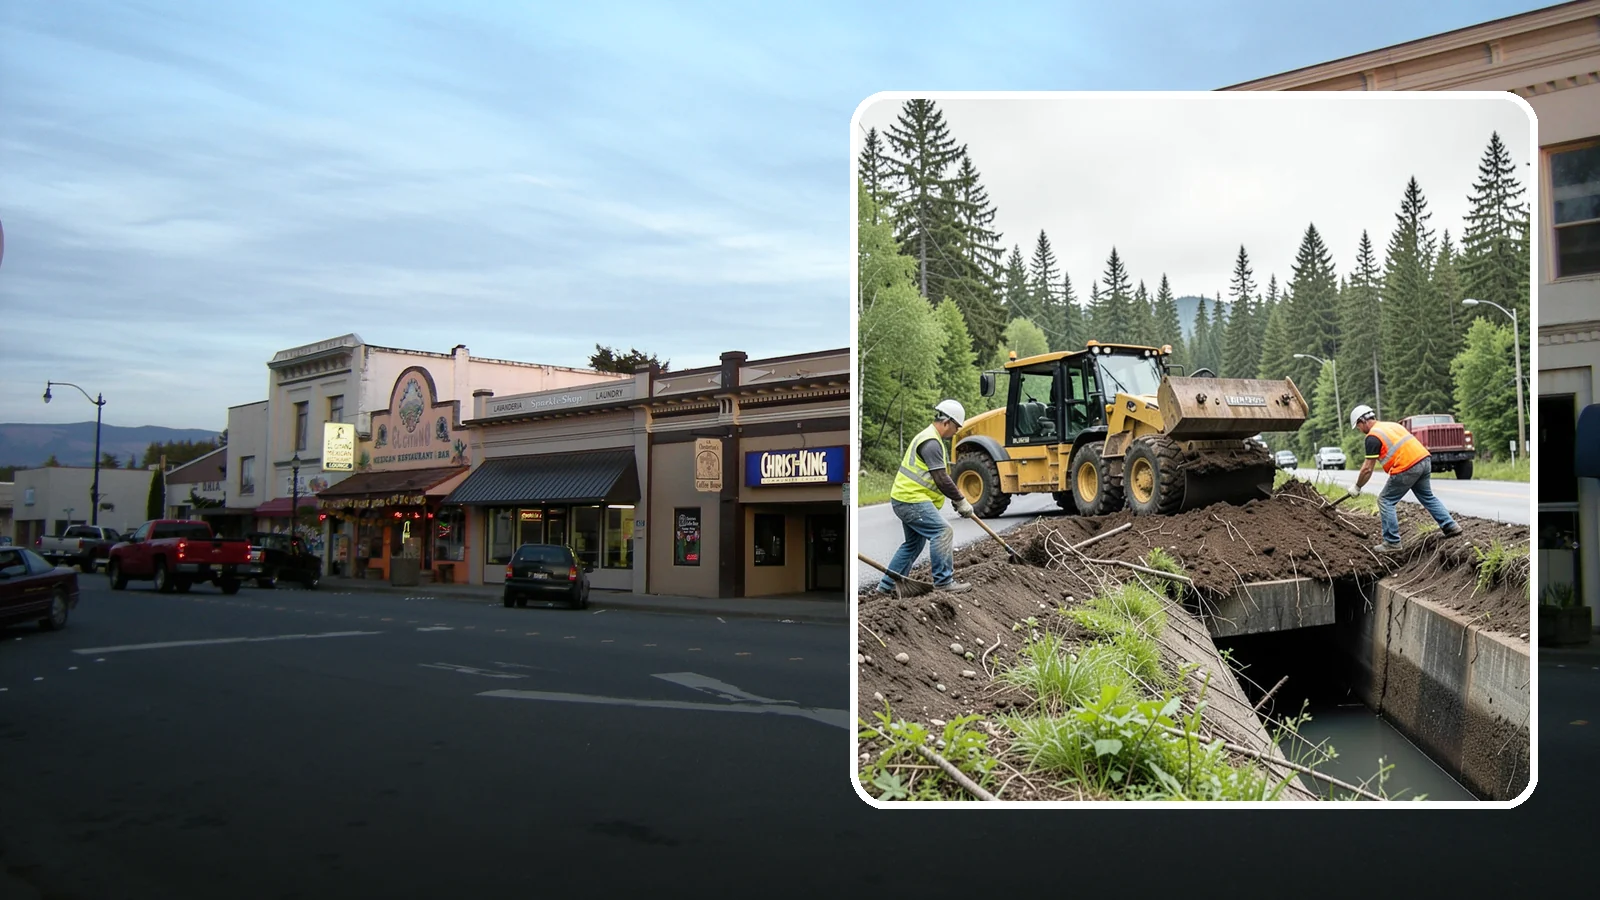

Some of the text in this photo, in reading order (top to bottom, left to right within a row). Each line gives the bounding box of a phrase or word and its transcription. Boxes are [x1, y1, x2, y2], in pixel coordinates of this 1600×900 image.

[561, 394, 582, 404] Shop
[595, 389, 624, 400] LAUNDRY
[493, 402, 523, 412] LAVANDERIA
[374, 450, 450, 464] MEXICAN RESTAURANT BAR
[761, 450, 827, 478] CHRIST KING
[696, 480, 709, 489] Coffee
